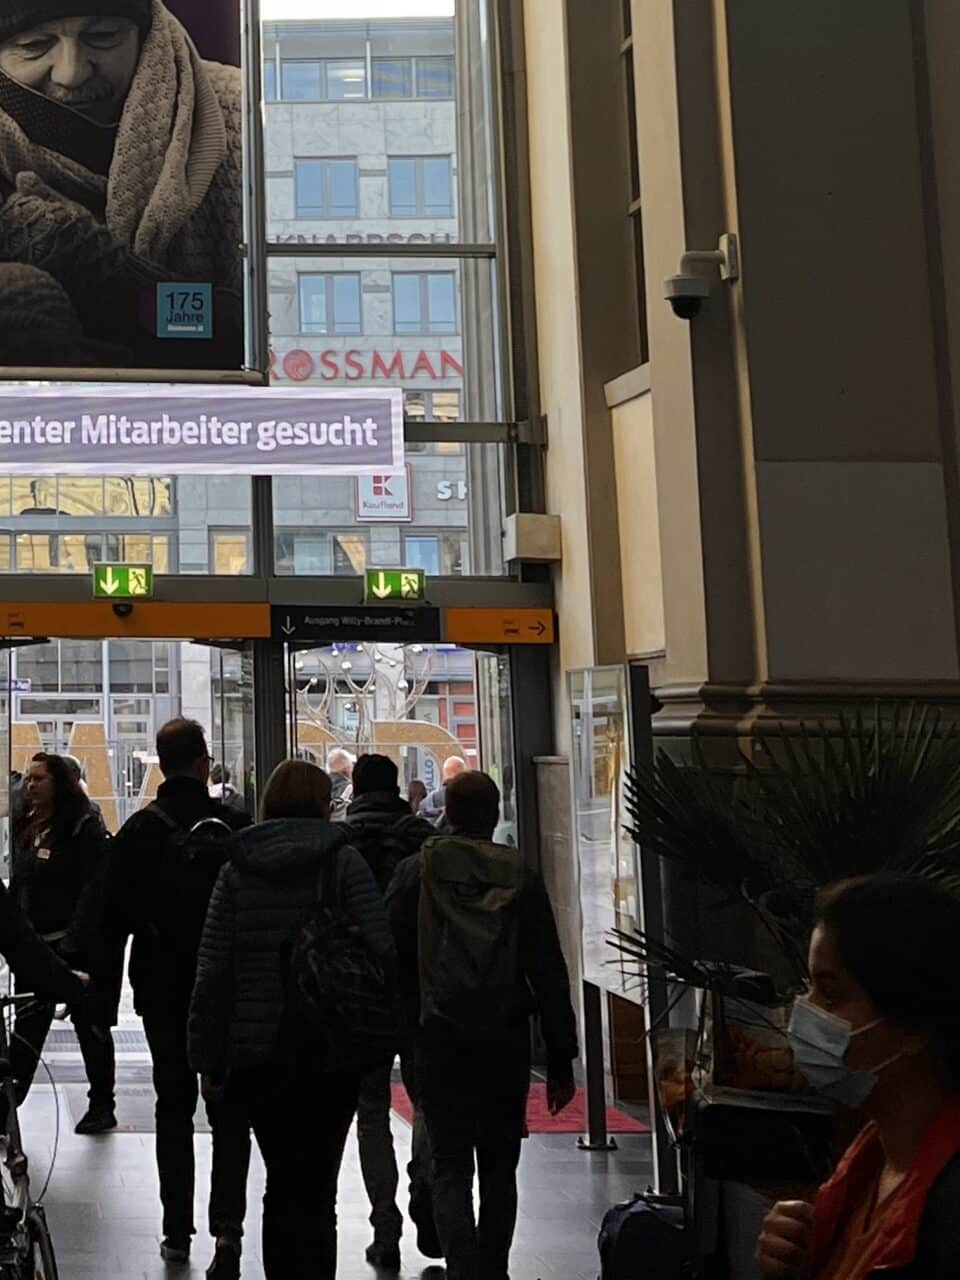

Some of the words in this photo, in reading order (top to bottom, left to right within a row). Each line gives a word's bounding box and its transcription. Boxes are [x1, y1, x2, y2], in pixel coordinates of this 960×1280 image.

[165, 291, 205, 311] 175
[80, 414, 252, 447] Mitarbeiter
[256, 419, 378, 451] gesucht
